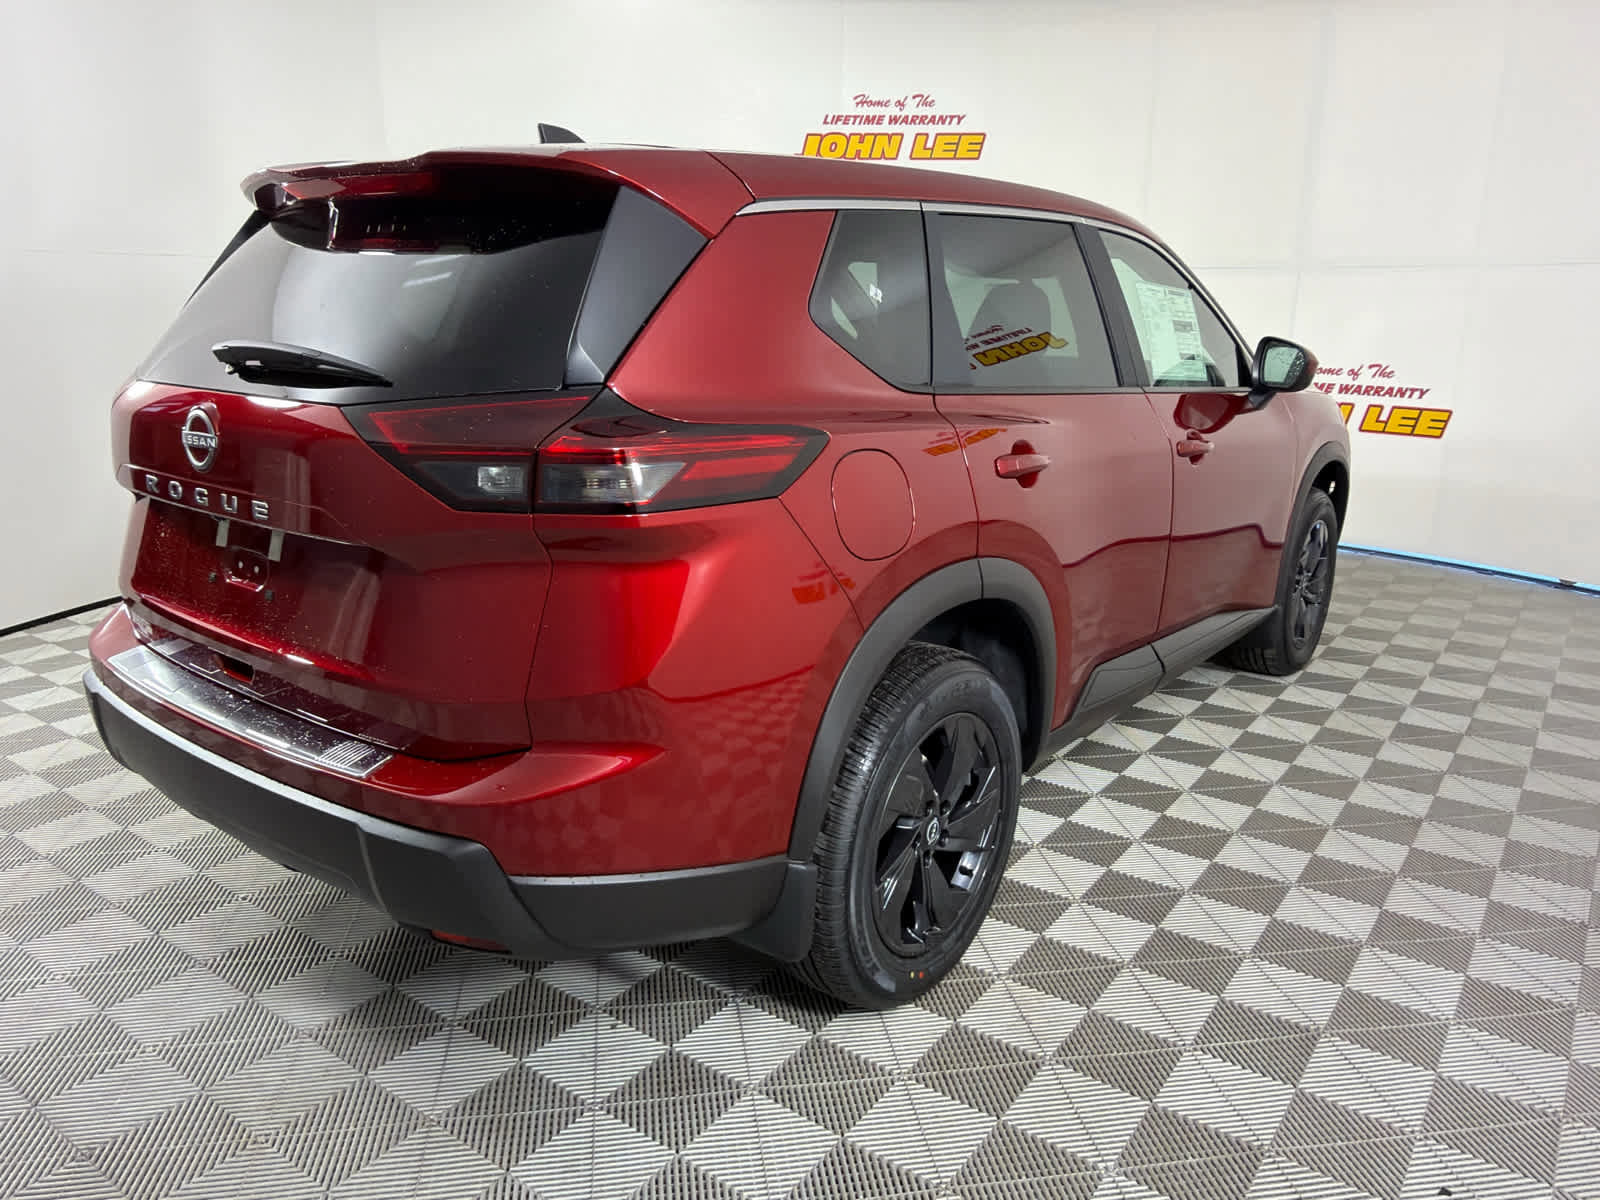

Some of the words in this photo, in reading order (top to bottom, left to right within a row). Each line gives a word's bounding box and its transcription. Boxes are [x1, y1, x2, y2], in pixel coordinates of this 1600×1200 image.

[853, 93, 890, 108] Home
[894, 95, 908, 111] of
[912, 93, 935, 108] The
[822, 114, 885, 125] LIFETIME
[888, 114, 966, 125] WARRANTY
[909, 132, 986, 160] LEE
[1316, 366, 1344, 376] ome
[1347, 364, 1364, 381] of
[1368, 363, 1396, 379] The
[1337, 383, 1430, 400] WARRANTY
[1359, 403, 1453, 439] LEE
[183, 433, 216, 448] SSAN
[145, 473, 269, 520] ROGUE
